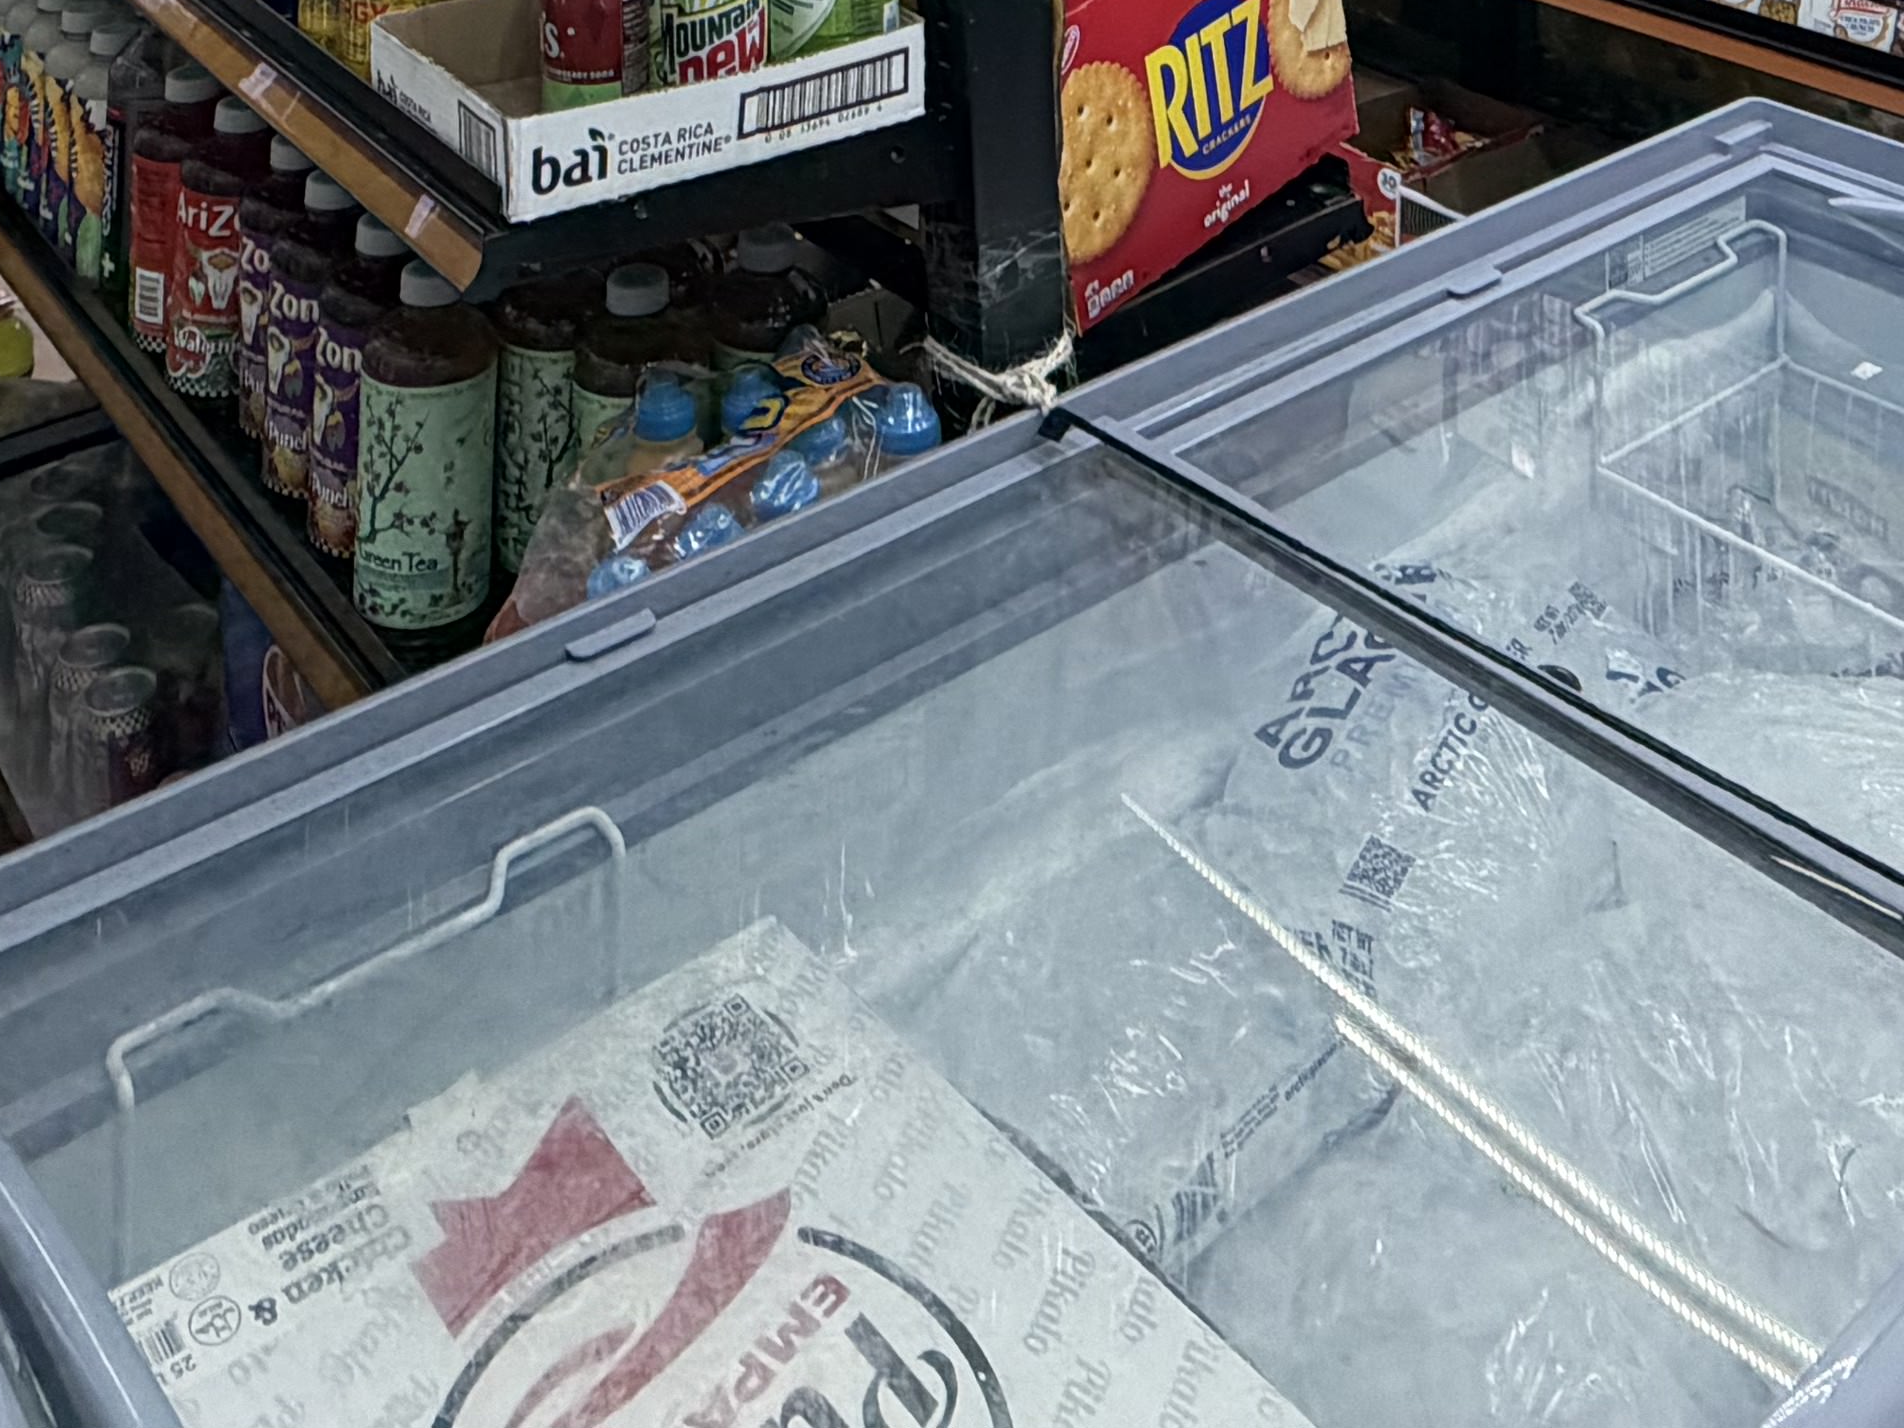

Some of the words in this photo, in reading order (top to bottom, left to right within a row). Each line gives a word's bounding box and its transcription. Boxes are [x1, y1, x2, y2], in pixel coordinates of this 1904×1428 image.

[618, 130, 672, 156] COSTA
[676, 122, 714, 143] RICA
[1201, 115, 1252, 155] CRACKERS
[531, 126, 608, 196] bai
[1203, 179, 1251, 228] original
[1217, 181, 1233, 200] the
[402, 550, 439, 573] Tea
[1410, 712, 1478, 812] ARCTIC
[277, 1202, 392, 1273] Cheese
[247, 1295, 280, 1327] &
